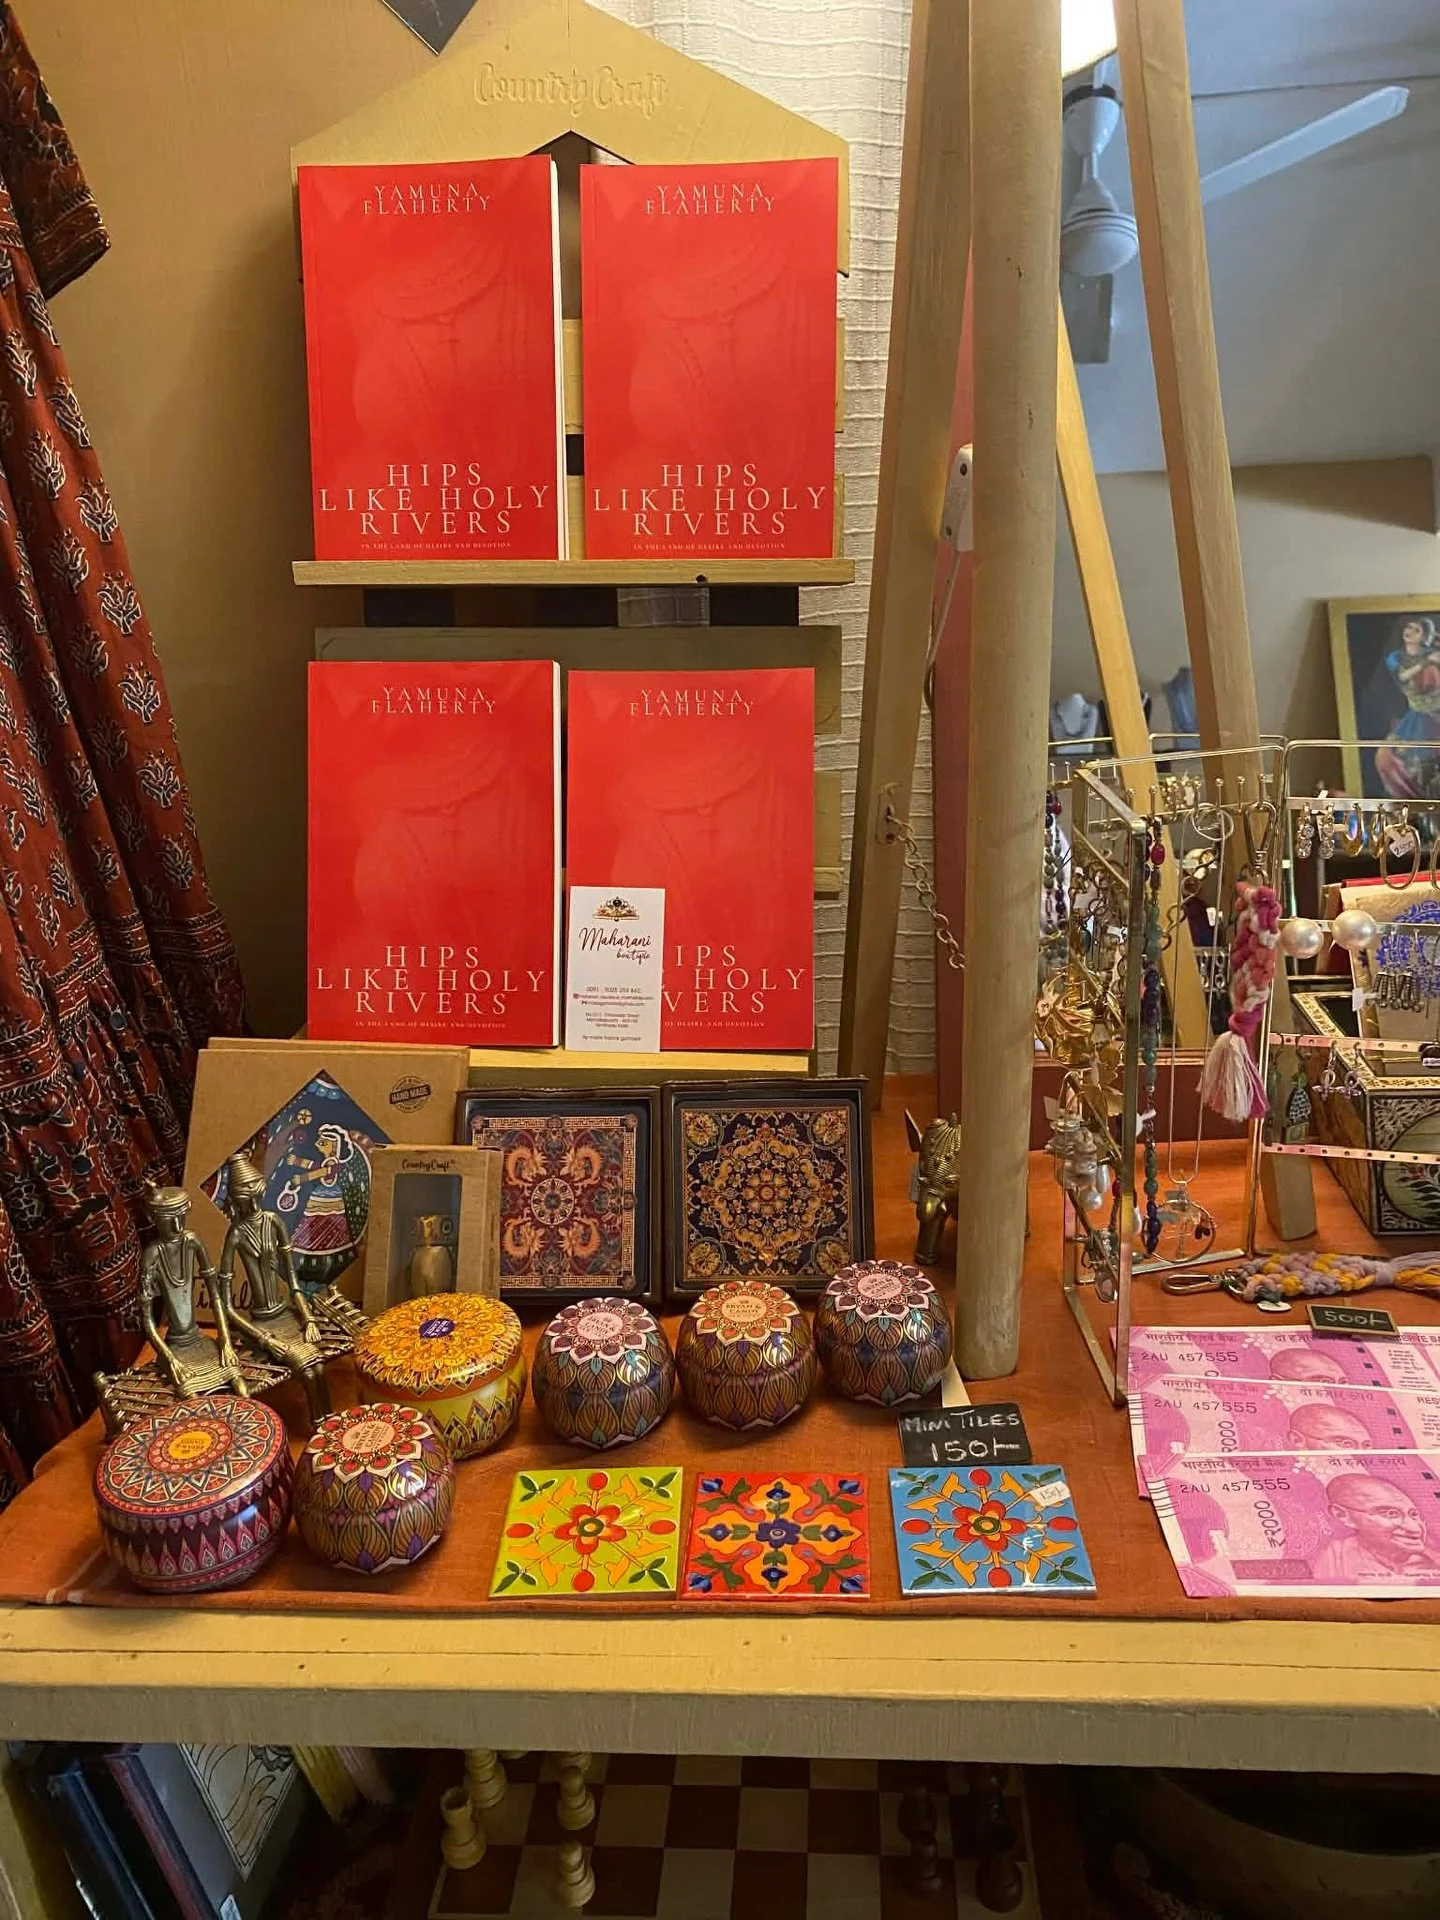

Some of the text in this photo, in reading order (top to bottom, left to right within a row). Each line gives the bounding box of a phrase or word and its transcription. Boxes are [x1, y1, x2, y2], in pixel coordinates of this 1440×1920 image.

[474, 62, 668, 120] Country Craft
[374, 181, 479, 200] YAMUNA
[657, 182, 764, 200] YAMUNA
[363, 195, 490, 215] FLAHERTY
[645, 196, 775, 215] FLAHERTY
[387, 462, 482, 488] HIPS
[661, 462, 758, 488] HIPS
[319, 484, 549, 512] LIKE HOLY
[592, 485, 826, 512] LIKE HOLY
[359, 510, 511, 536] RIVERS
[632, 511, 785, 536] RIVERS
[383, 686, 485, 701] YAMUNA
[640, 689, 743, 703] YAMUNA
[371, 699, 496, 714] FLAHERTY
[629, 701, 754, 716] FLAHERTY
[579, 927, 652, 952] Maharani
[385, 945, 480, 969] HIPS
[674, 944, 737, 968] IPS
[316, 967, 545, 993] LIKE HOLY
[693, 967, 806, 991] HOLY
[354, 990, 506, 1015] RIVERS
[662, 990, 766, 1014] VERS
[391, 1086, 428, 1103] HAND MADE
[1141, 1351, 1239, 1362] 2AU 457555
[1154, 1400, 1258, 1414] 2AU 457555
[949, 1409, 1020, 1430] TILES
[1180, 1478, 1291, 1493] 2AU 457555
